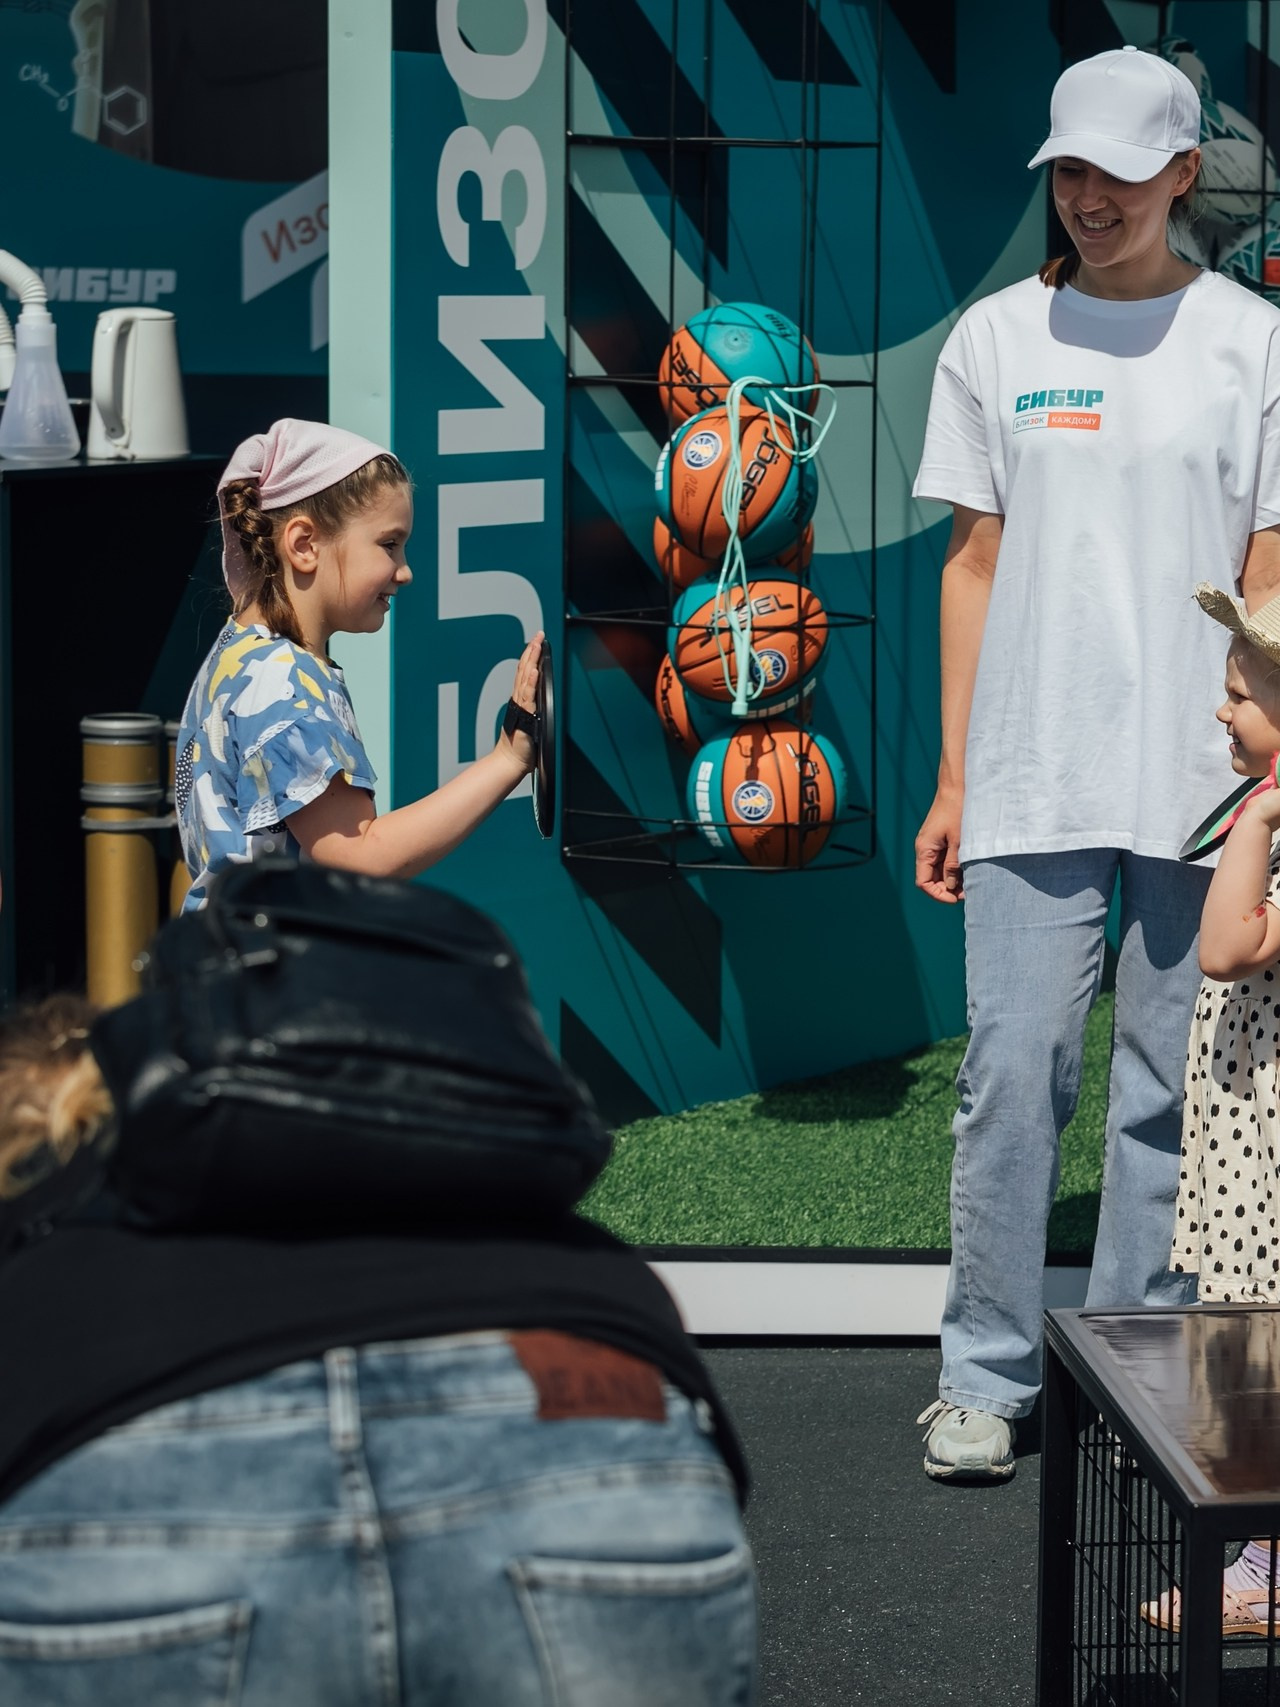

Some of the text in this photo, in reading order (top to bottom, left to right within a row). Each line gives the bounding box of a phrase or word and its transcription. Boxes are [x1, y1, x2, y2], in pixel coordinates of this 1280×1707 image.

[1015, 389, 1104, 413] СИБУР
[1016, 416, 1097, 428] БЛИЗОК КАЖДОМУ
[721, 426, 780, 516] JÖGE
